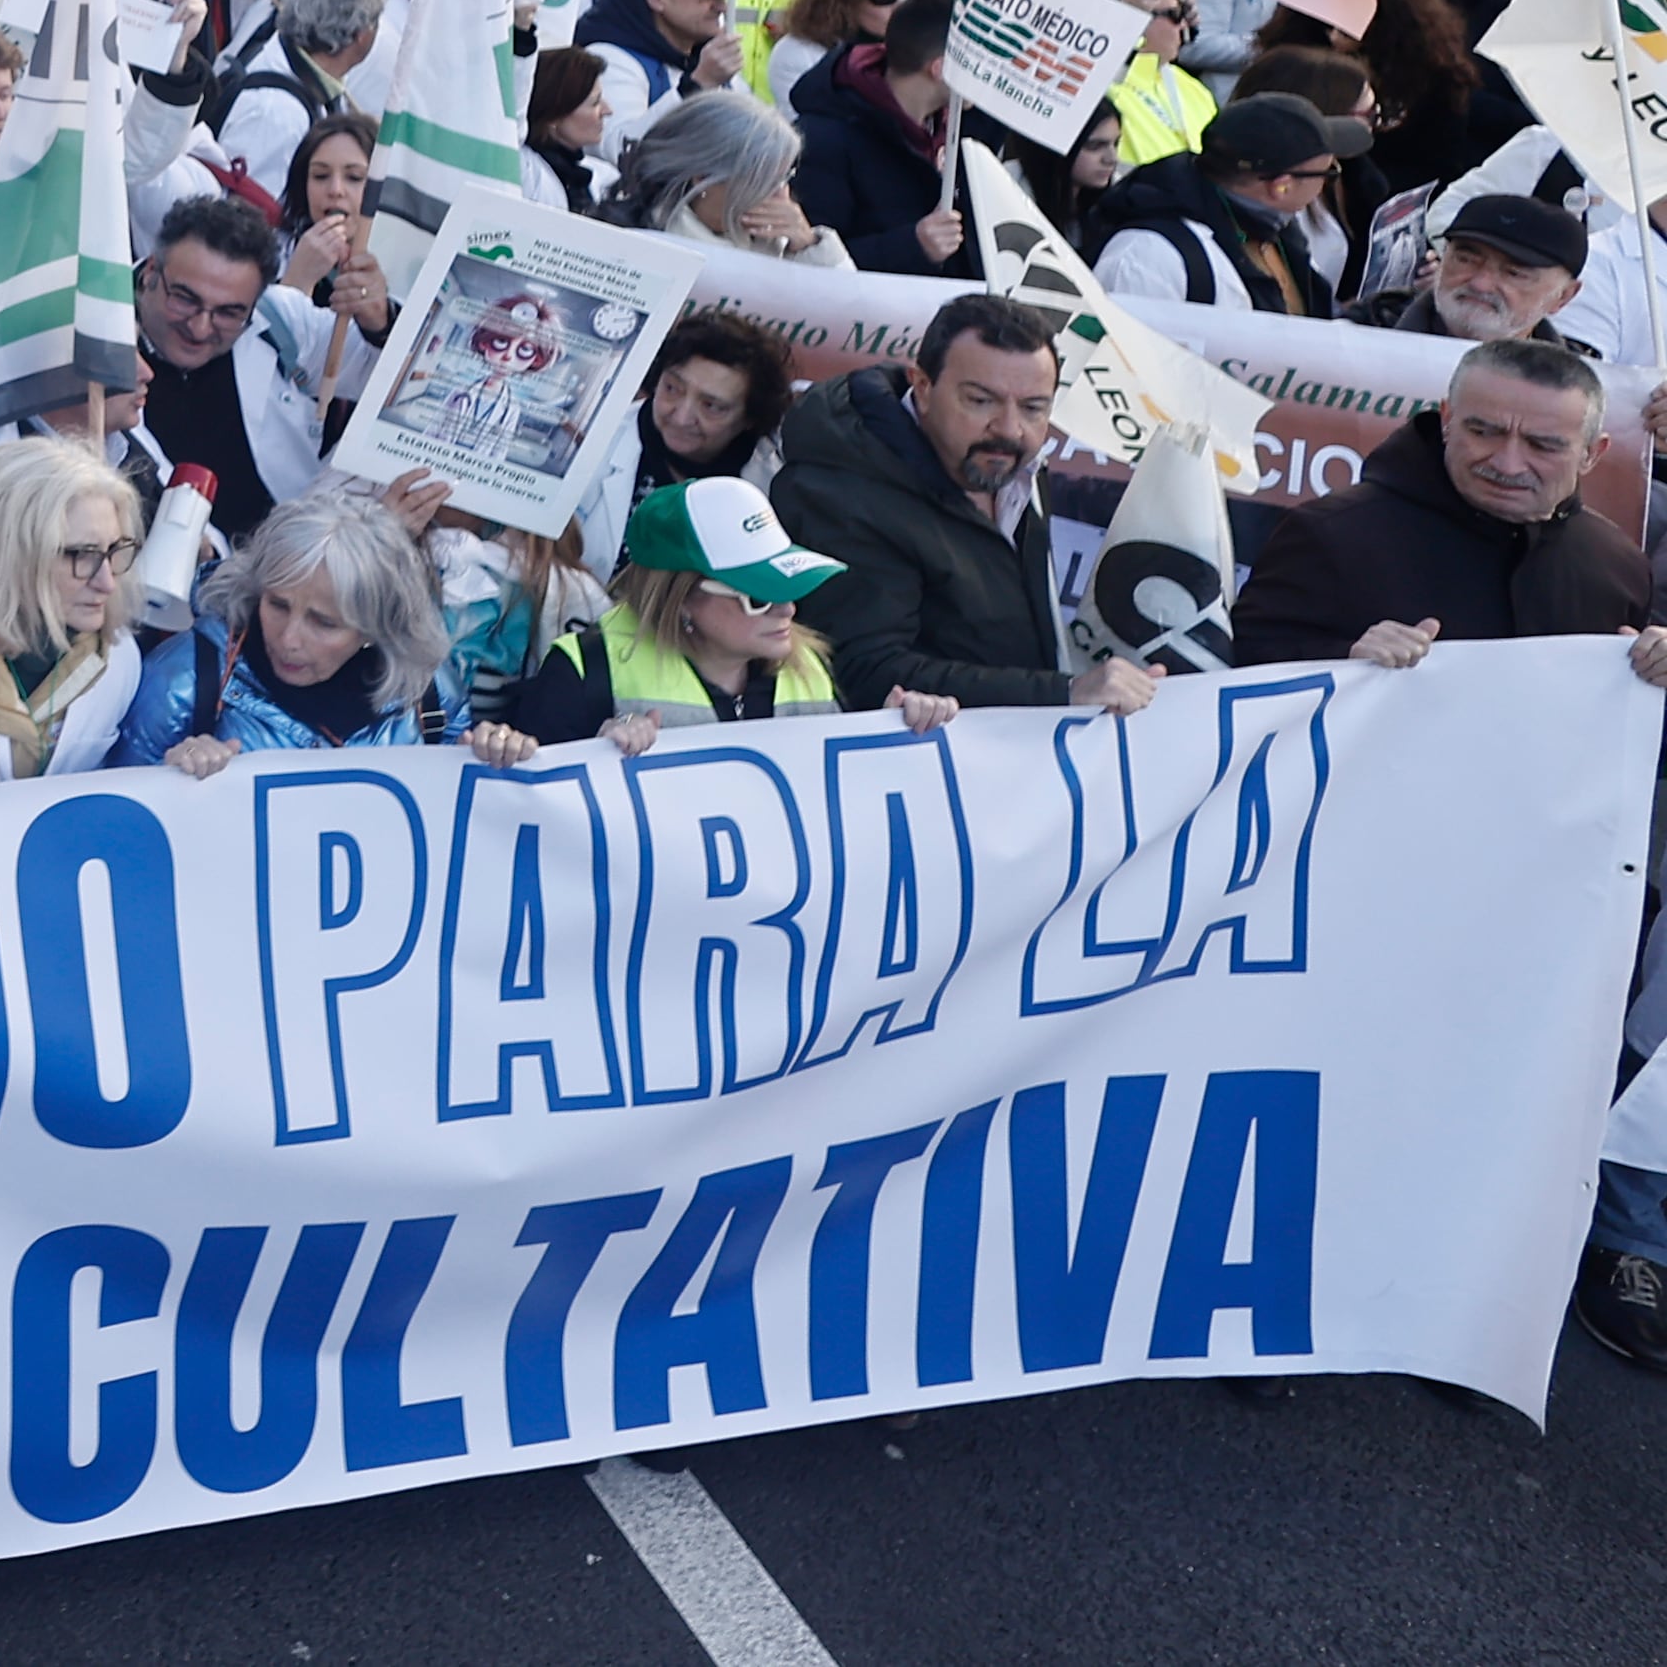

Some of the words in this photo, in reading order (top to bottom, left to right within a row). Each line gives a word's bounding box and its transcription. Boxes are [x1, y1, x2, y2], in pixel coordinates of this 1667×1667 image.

[1029, 5, 1109, 60] MÉDICO
[994, 77, 1055, 119] Mancha
[467, 229, 512, 245] simex
[534, 264, 603, 298] profesionales
[562, 259, 607, 284] Estatuto
[608, 274, 638, 292] Marco
[377, 441, 421, 465] Nuestra
[422, 454, 477, 482] Profesión
[478, 473, 490, 485] se
[504, 483, 547, 504] merece
[396, 431, 450, 461] Estatuto
[452, 446, 493, 472] Marco
[495, 462, 538, 488] Propio
[256, 730, 974, 1147] PARA
[1020, 673, 1335, 1017] LA
